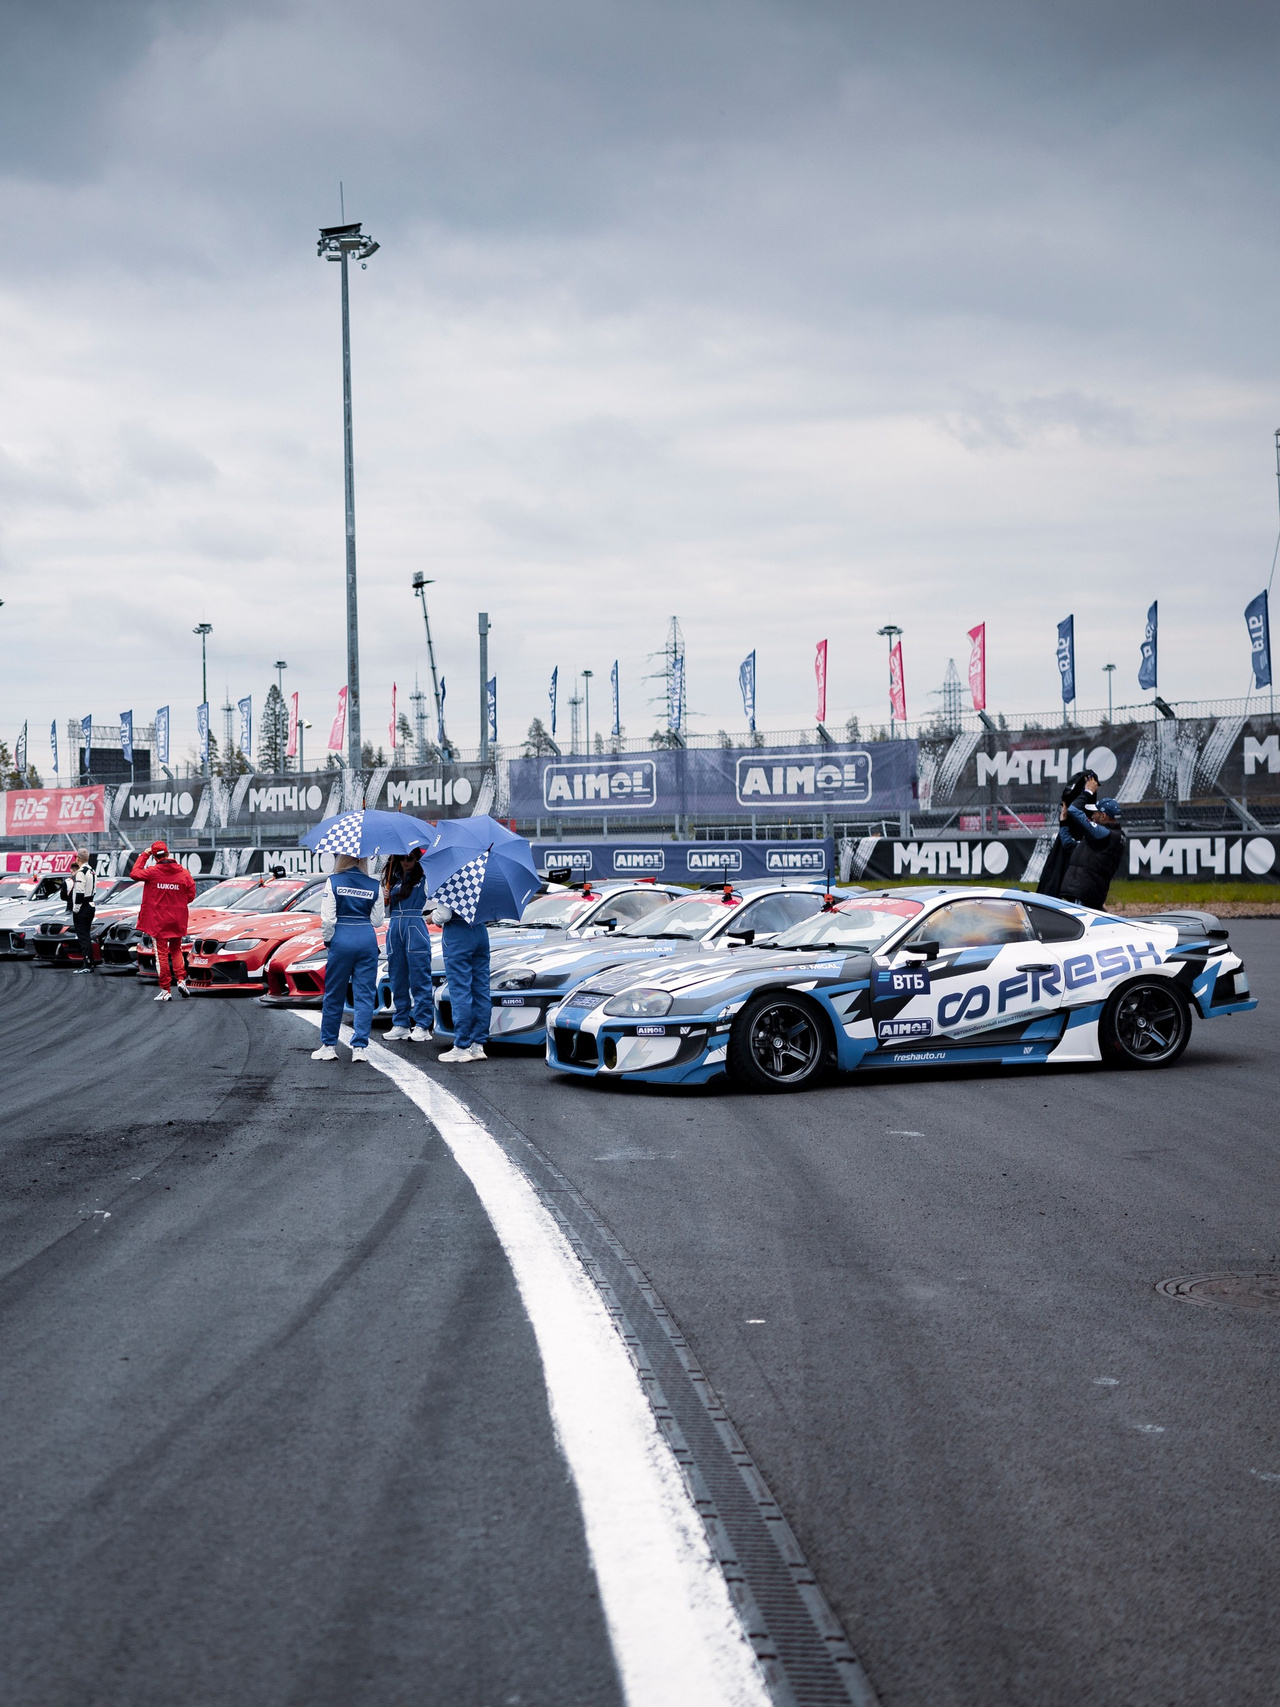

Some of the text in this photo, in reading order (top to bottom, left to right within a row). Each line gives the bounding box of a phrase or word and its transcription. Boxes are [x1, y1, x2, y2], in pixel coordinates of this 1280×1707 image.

[548, 769, 651, 800] AIMOL
[742, 762, 865, 797] AIMOL
[547, 853, 590, 868] AIMOL
[615, 853, 662, 868] AIMOL
[689, 853, 740, 869] AIMOL
[768, 852, 824, 869] AIMOL
[156, 883, 180, 891] LUKOIL
[893, 973, 924, 991] ВТБ
[638, 1026, 664, 1035] AIMOL
[880, 1022, 931, 1038] AIMOL
[893, 1050, 946, 1062] freshauto.ru
